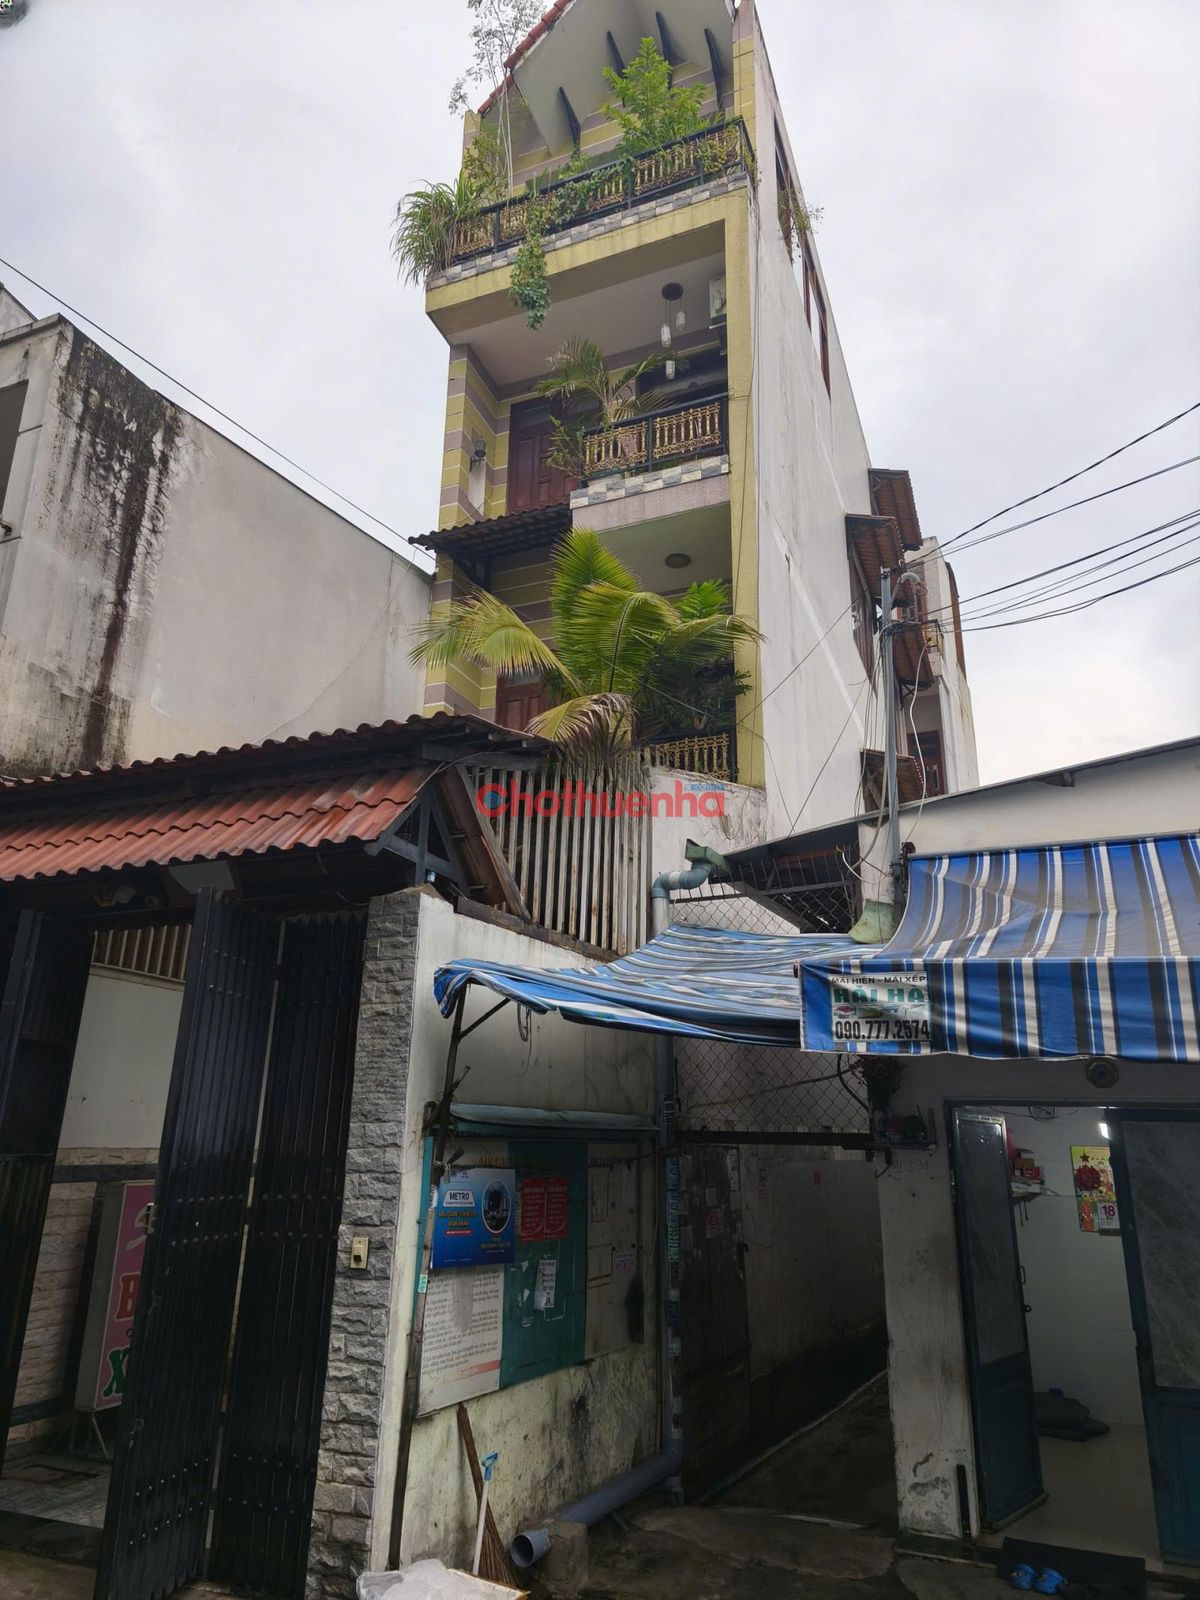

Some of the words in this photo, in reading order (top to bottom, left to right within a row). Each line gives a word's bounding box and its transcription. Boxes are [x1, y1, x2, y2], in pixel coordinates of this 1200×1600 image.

[835, 1020, 930, 1039] 090.777.2574
[449, 1192, 469, 1200] METRO
[1102, 1205, 1115, 1216] 18
